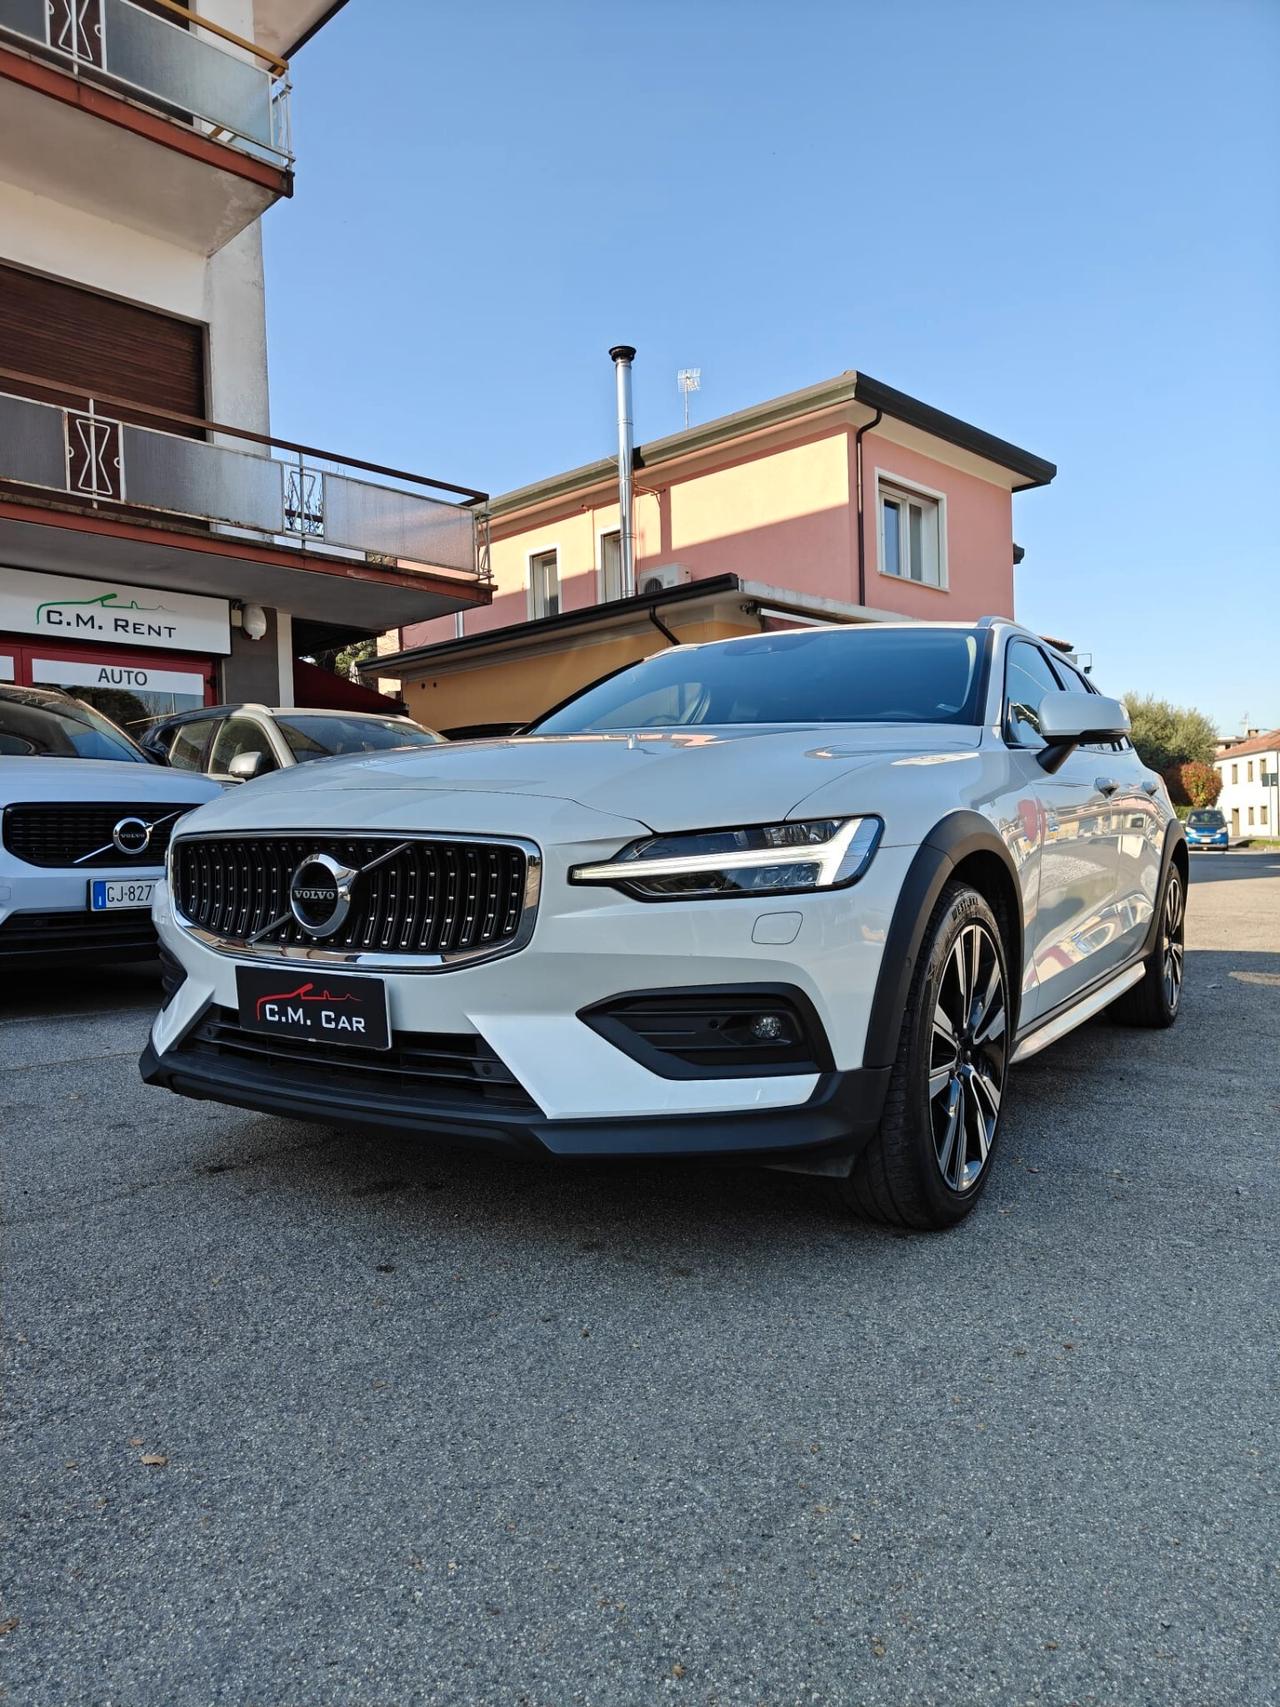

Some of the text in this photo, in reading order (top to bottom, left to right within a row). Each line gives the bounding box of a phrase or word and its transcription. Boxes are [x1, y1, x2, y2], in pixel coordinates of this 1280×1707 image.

[46, 609, 177, 638] C.M. RENT
[97, 667, 148, 686] AUTO
[294, 890, 335, 899] VOLVO
[265, 1004, 366, 1033] C.M. CAR
